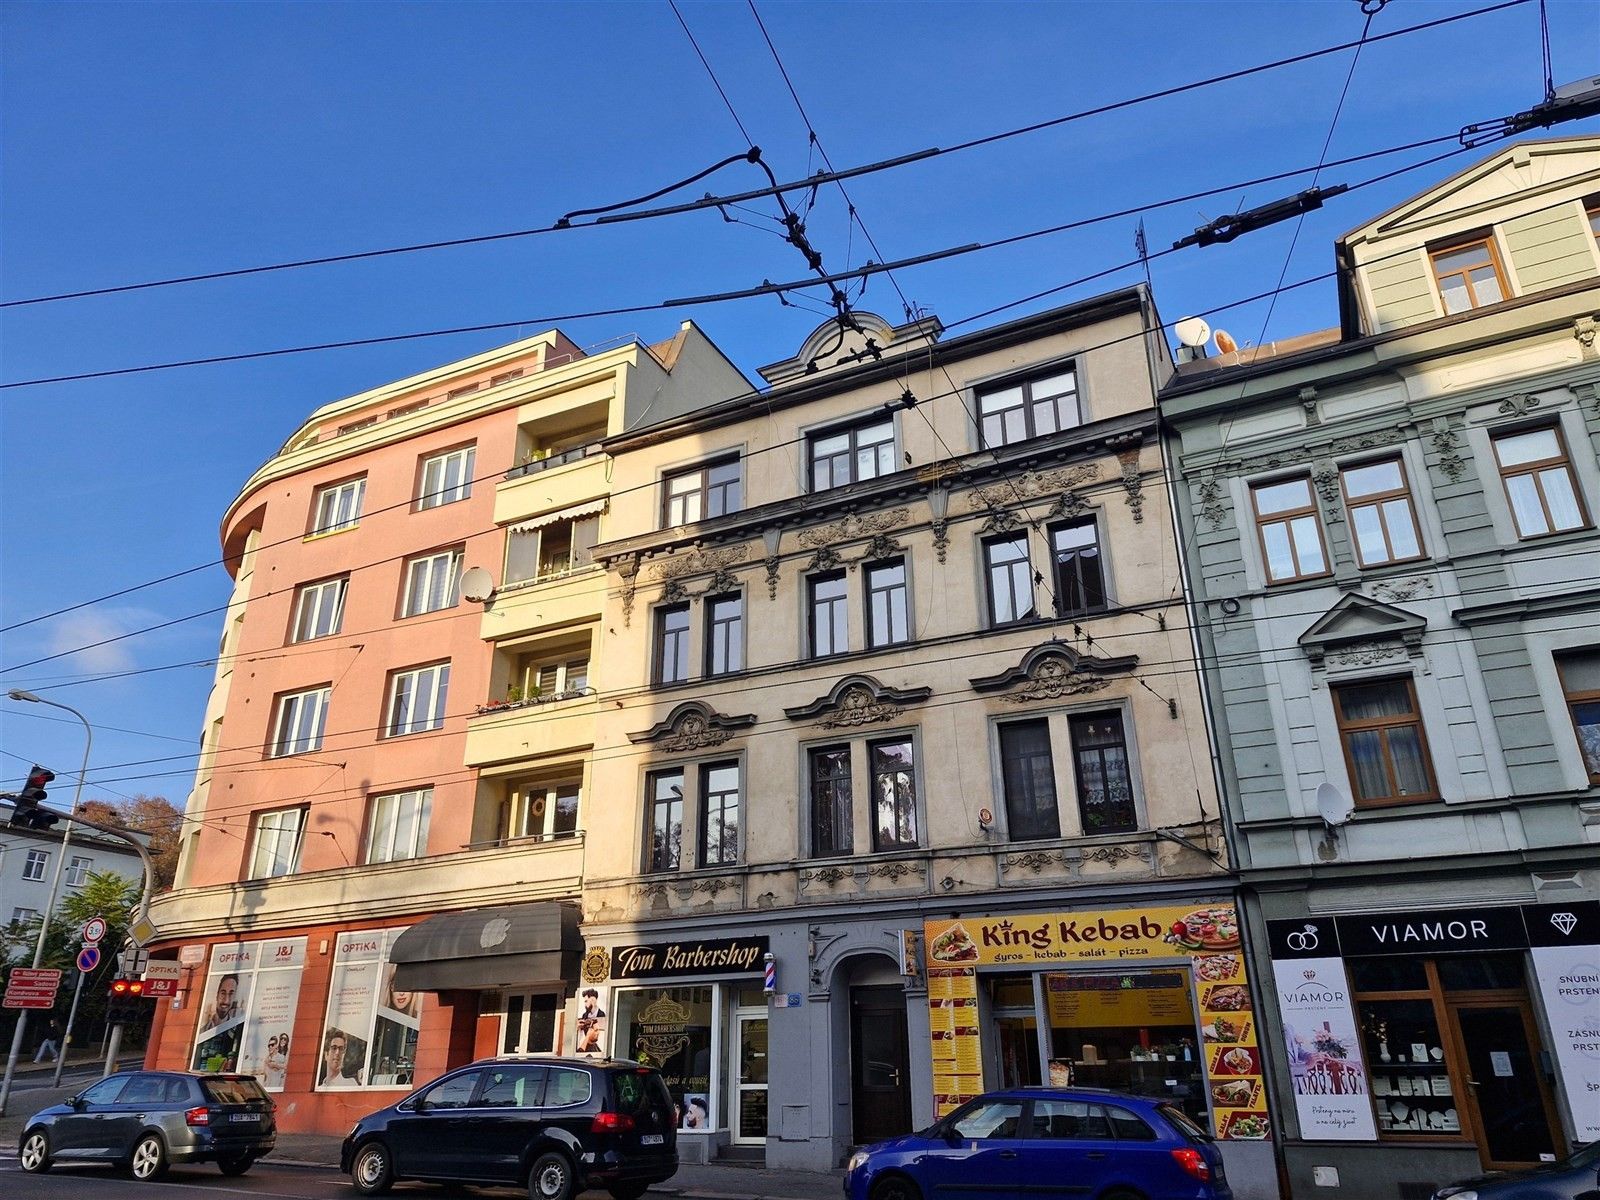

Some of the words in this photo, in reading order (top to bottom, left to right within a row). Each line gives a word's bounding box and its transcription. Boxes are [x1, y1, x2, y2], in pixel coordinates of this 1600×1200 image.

[981, 920, 1051, 950] King
[1059, 915, 1162, 944] Kebab
[1371, 920, 1488, 943] VIAMOR
[275, 946, 294, 957] J&J
[342, 941, 377, 953] OPTIKA
[219, 952, 250, 963] OPTIKA
[618, 946, 656, 977] Tom
[662, 942, 760, 969] Barbershop
[994, 953, 1024, 963] gyros
[1034, 949, 1067, 959] kebab
[1078, 946, 1107, 957] salát
[1118, 947, 1149, 958] pizza
[148, 966, 178, 974] OPTIKA
[1231, 961, 1241, 978] PIZZA
[1559, 973, 1600, 984] SNUBNÍ
[150, 980, 171, 990] J&J
[1201, 987, 1211, 1006] KEBAB
[1283, 991, 1344, 1003] VIAMOR
[1558, 987, 1600, 996] PRSTEN
[1572, 1043, 1600, 1051] PRST
[1249, 1083, 1262, 1109] FALAFEL
